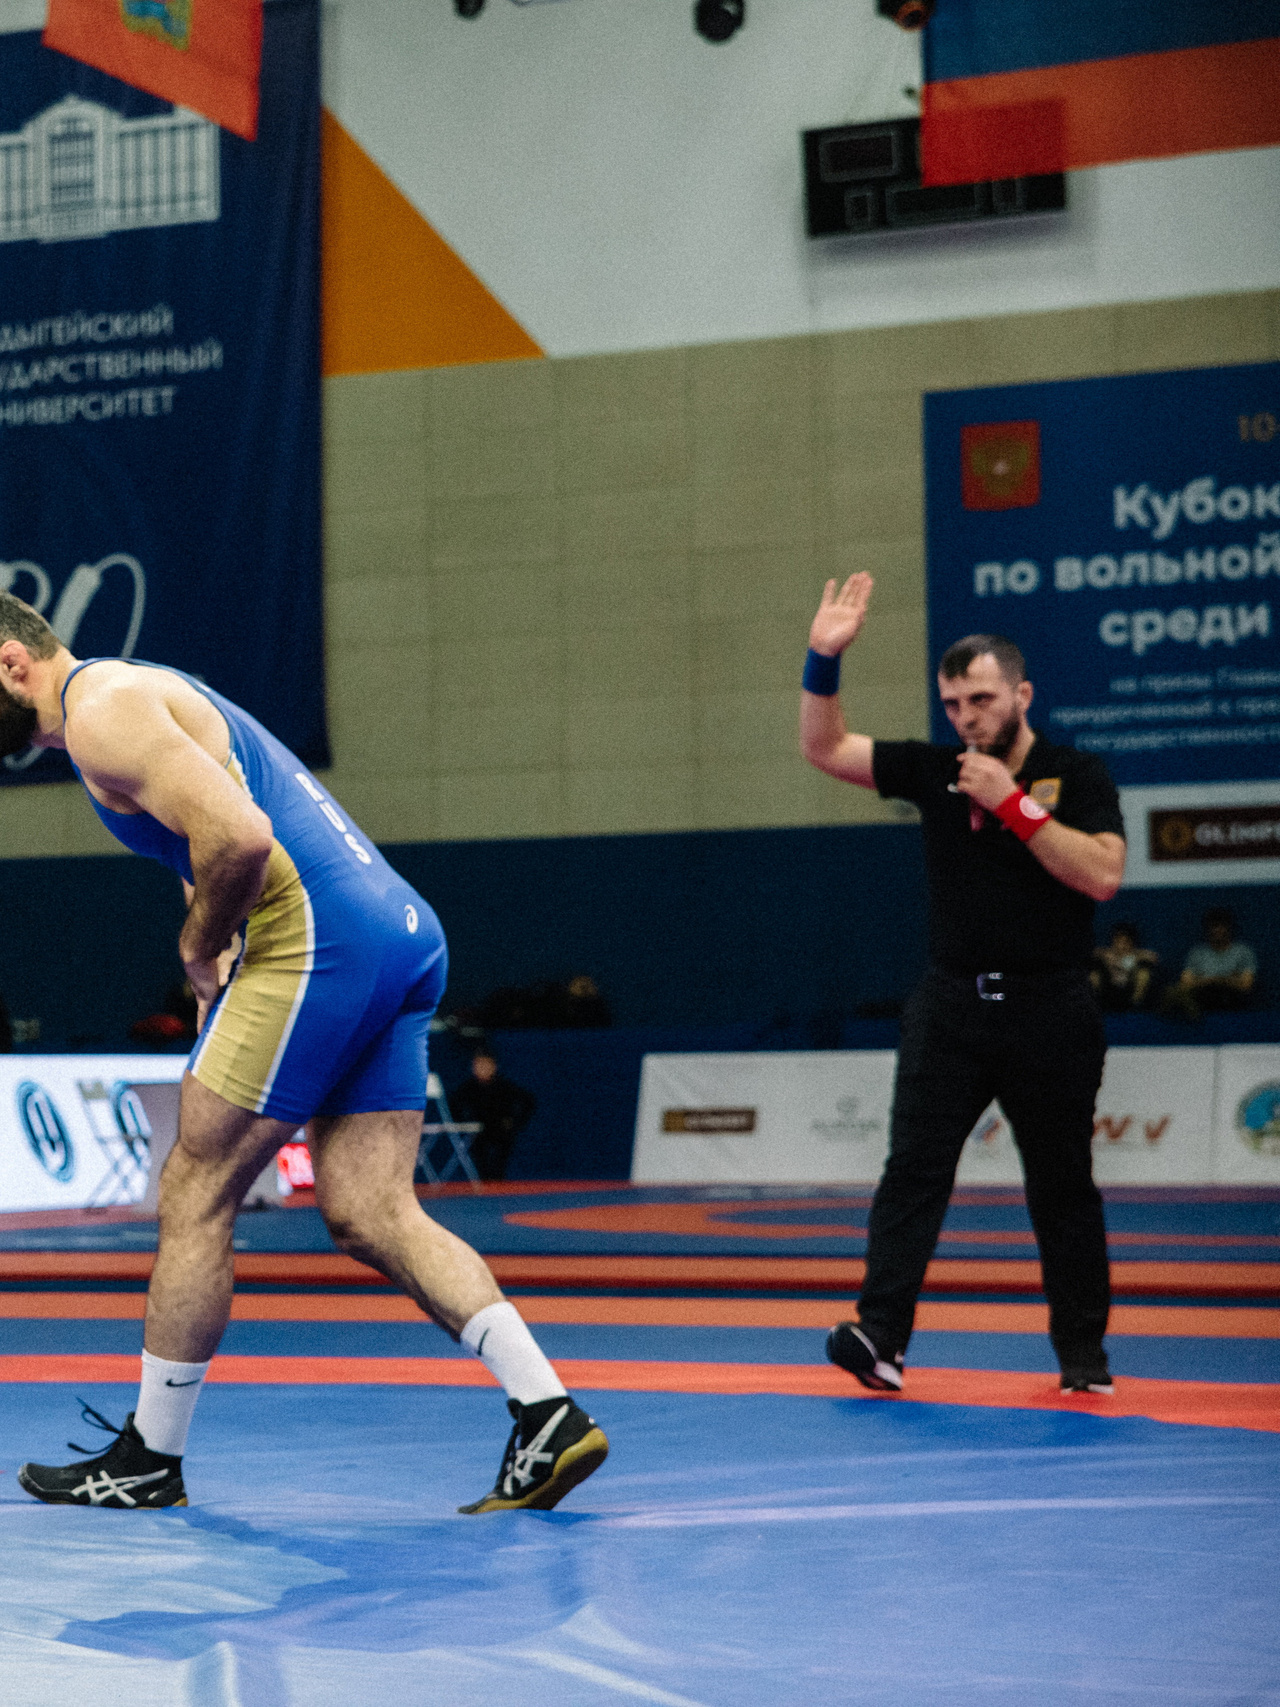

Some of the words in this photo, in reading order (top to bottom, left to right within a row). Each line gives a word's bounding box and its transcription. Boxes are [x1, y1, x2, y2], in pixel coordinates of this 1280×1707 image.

[1113, 476, 1280, 540] Кубок
[974, 560, 1041, 597] по
[1054, 532, 1280, 592] вольной
[1099, 602, 1270, 655] среди
